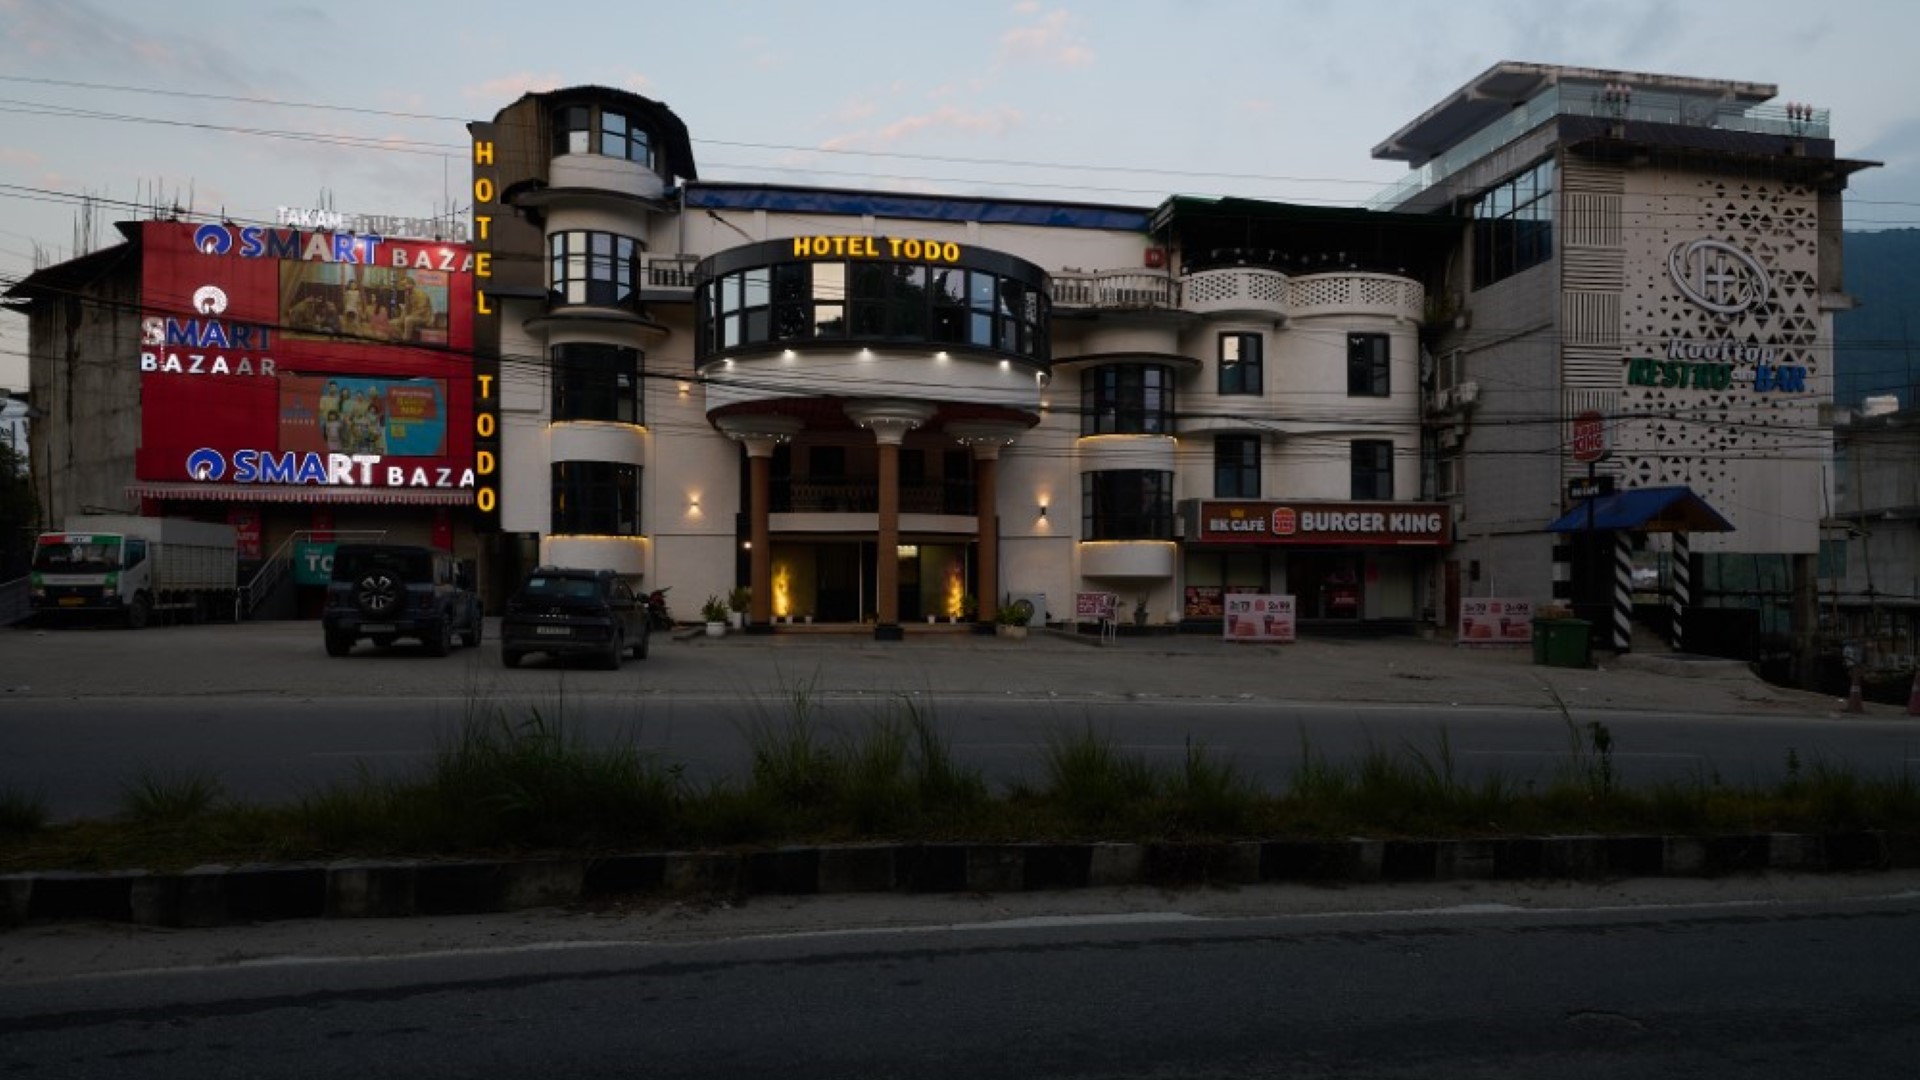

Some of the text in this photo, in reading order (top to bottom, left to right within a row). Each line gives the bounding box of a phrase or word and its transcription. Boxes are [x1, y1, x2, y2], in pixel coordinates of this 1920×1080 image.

[240, 227, 383, 265] SMART
[793, 236, 960, 262] HOTEL TODO
[142, 317, 271, 348] SMART
[475, 139, 497, 514] HOTEL TODO
[141, 353, 276, 376] BAZAAR
[1755, 365, 1806, 392] BAR
[232, 450, 380, 486] SMART
[1231, 516, 1265, 531] CAFÉ
[1302, 511, 1384, 532] BURGER
[1389, 513, 1442, 533] KING
